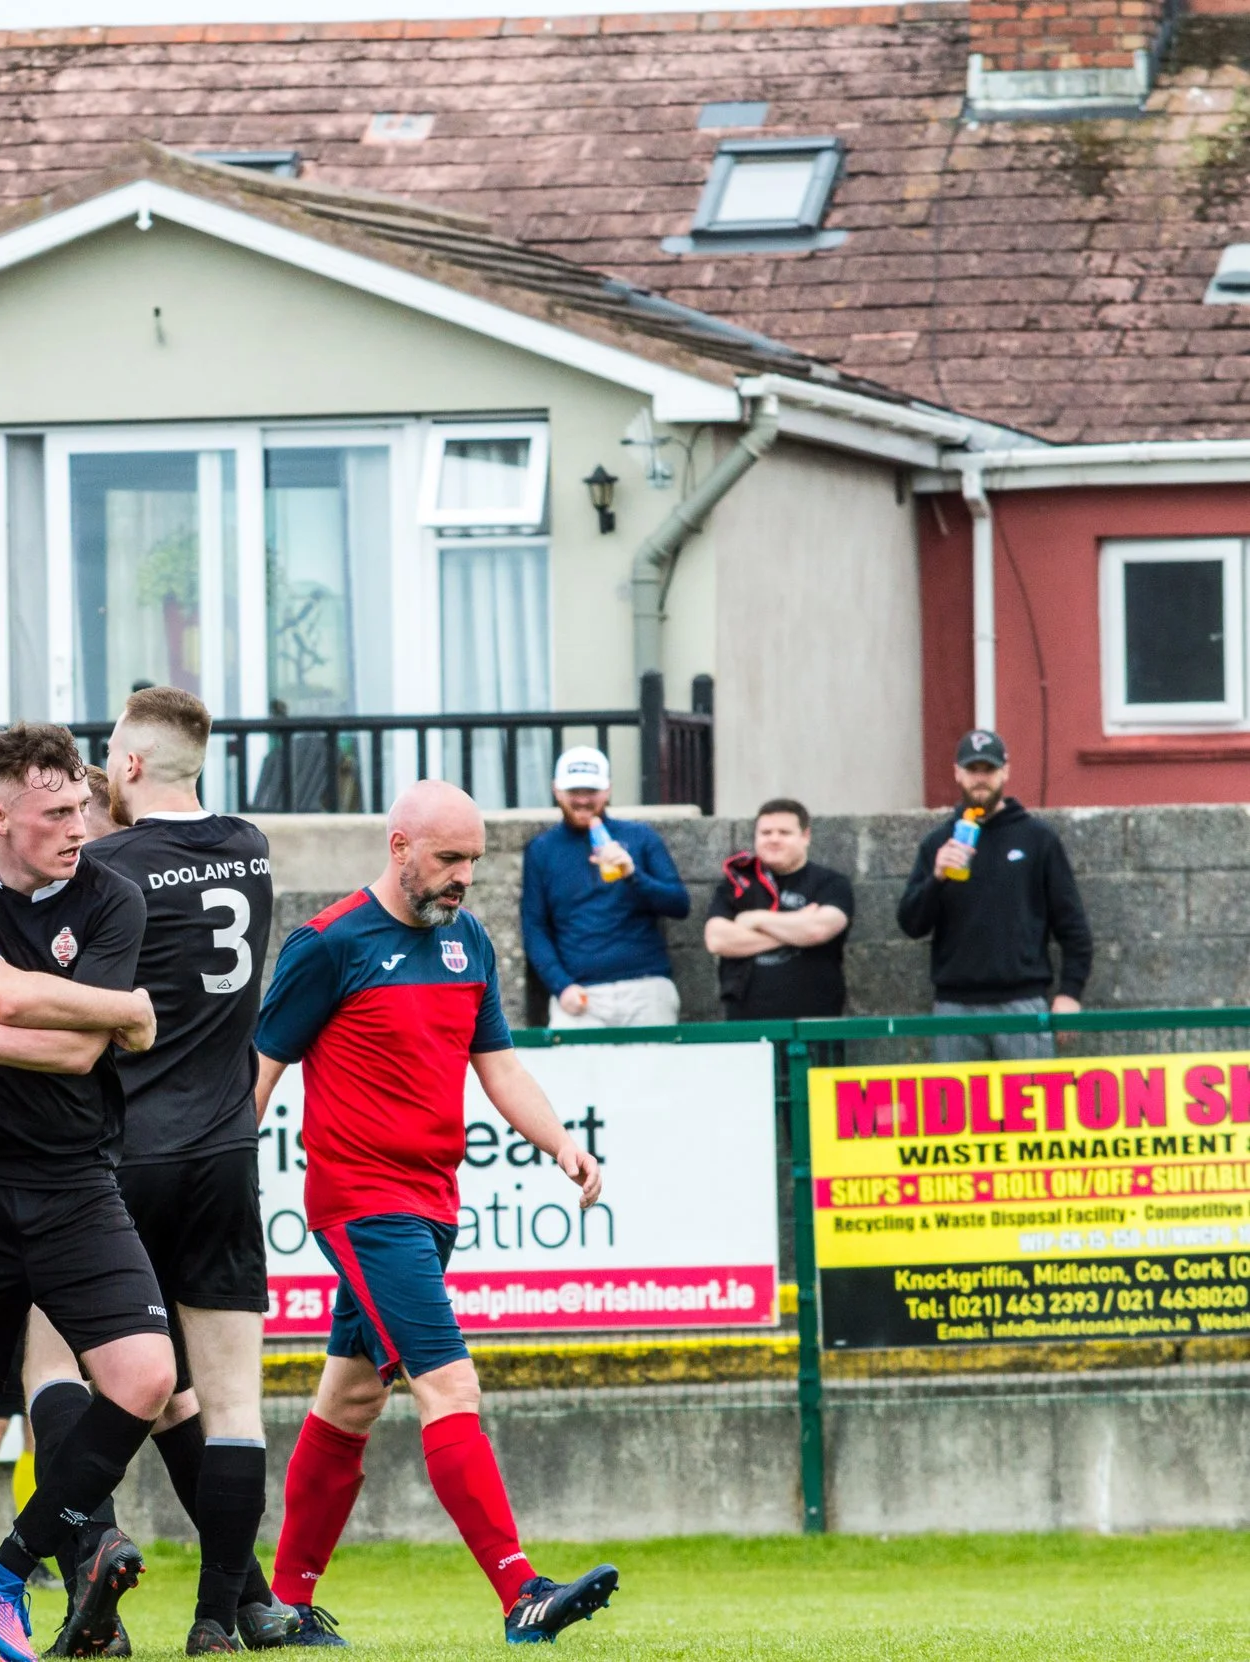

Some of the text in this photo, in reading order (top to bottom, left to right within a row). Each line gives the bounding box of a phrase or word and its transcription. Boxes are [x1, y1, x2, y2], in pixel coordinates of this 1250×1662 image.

[148, 861, 247, 889] DOOLAN'S
[200, 888, 253, 994] 3
[835, 1067, 1167, 1140] MIDLETON
[898, 1132, 1235, 1165] WASTE MANAGEMENT
[830, 1176, 901, 1207] SKIPS
[918, 1173, 975, 1203] BINS
[993, 1169, 1049, 1200] ROLL
[1050, 1166, 1134, 1198] ON/OFF
[834, 1214, 915, 1233] Recycling
[935, 1212, 986, 1229] Waste
[991, 1208, 1062, 1227] Disposal
[1067, 1206, 1125, 1223] Facility
[1145, 1202, 1243, 1220] Competitive
[894, 1265, 1030, 1294] Knockgriffin,
[1033, 1262, 1132, 1286] Midleton,
[1135, 1259, 1170, 1282] Co.
[1173, 1257, 1226, 1280] Cork
[285, 1288, 324, 1319] 25
[449, 1279, 756, 1321] helpline@irishheart.ie
[905, 1297, 945, 1320] Tel:
[949, 1293, 1002, 1320] (021)
[1006, 1292, 1045, 1316] 463
[1049, 1290, 1100, 1315] 2393
[1117, 1288, 1154, 1312] 021
[1159, 1284, 1248, 1310] 4638020
[937, 1322, 989, 1341] Email:
